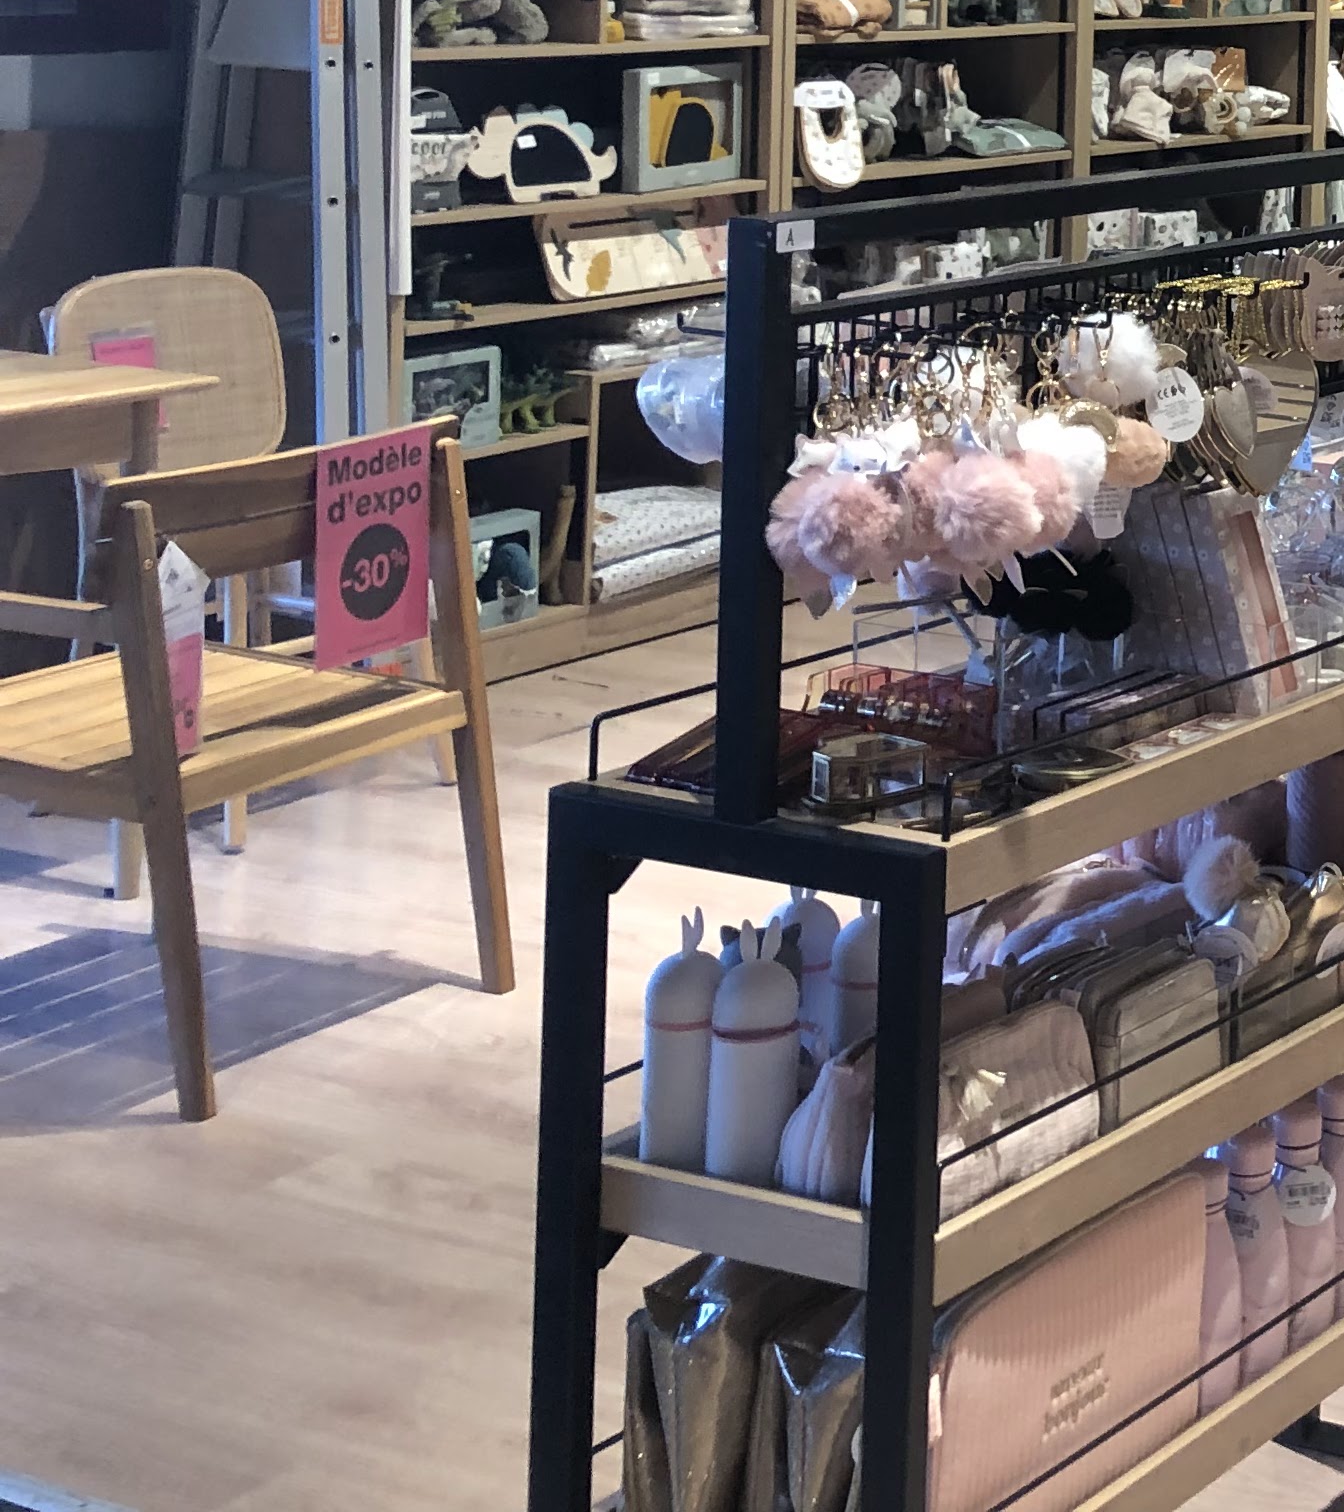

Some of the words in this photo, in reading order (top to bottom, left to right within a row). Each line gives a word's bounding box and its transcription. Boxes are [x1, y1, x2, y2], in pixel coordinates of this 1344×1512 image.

[785, 228, 795, 246] A
[327, 442, 422, 487] Modèle
[327, 481, 422, 525] d'expo
[341, 547, 408, 593] -30%
